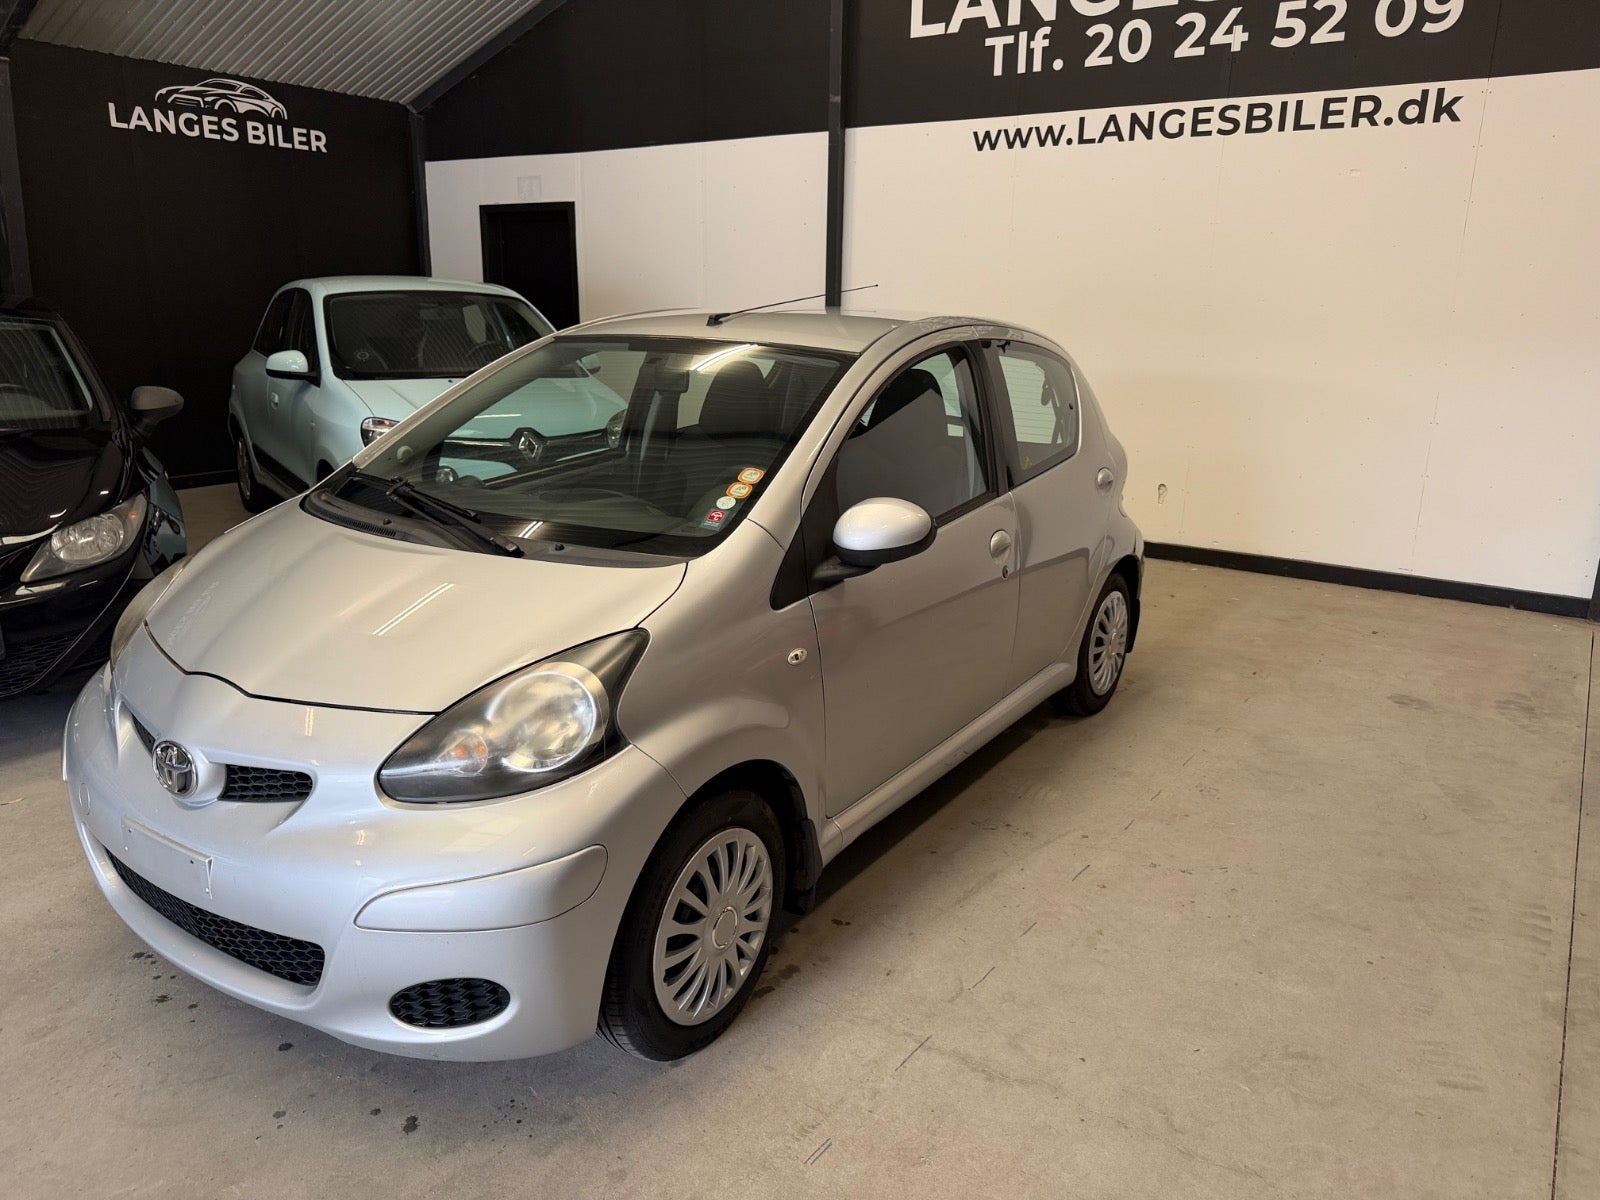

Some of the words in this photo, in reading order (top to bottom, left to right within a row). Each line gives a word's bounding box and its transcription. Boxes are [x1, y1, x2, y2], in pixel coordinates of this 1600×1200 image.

[985, 26, 1064, 76] Tlf.
[1084, 18, 1152, 68] 20
[1173, 6, 1249, 58] 24
[1270, 0, 1348, 48] 52
[1374, 0, 1465, 38] 09
[107, 102, 240, 142] LANGES
[246, 120, 328, 153] BILER
[972, 87, 1465, 152] www.LANGESBILER.dk
